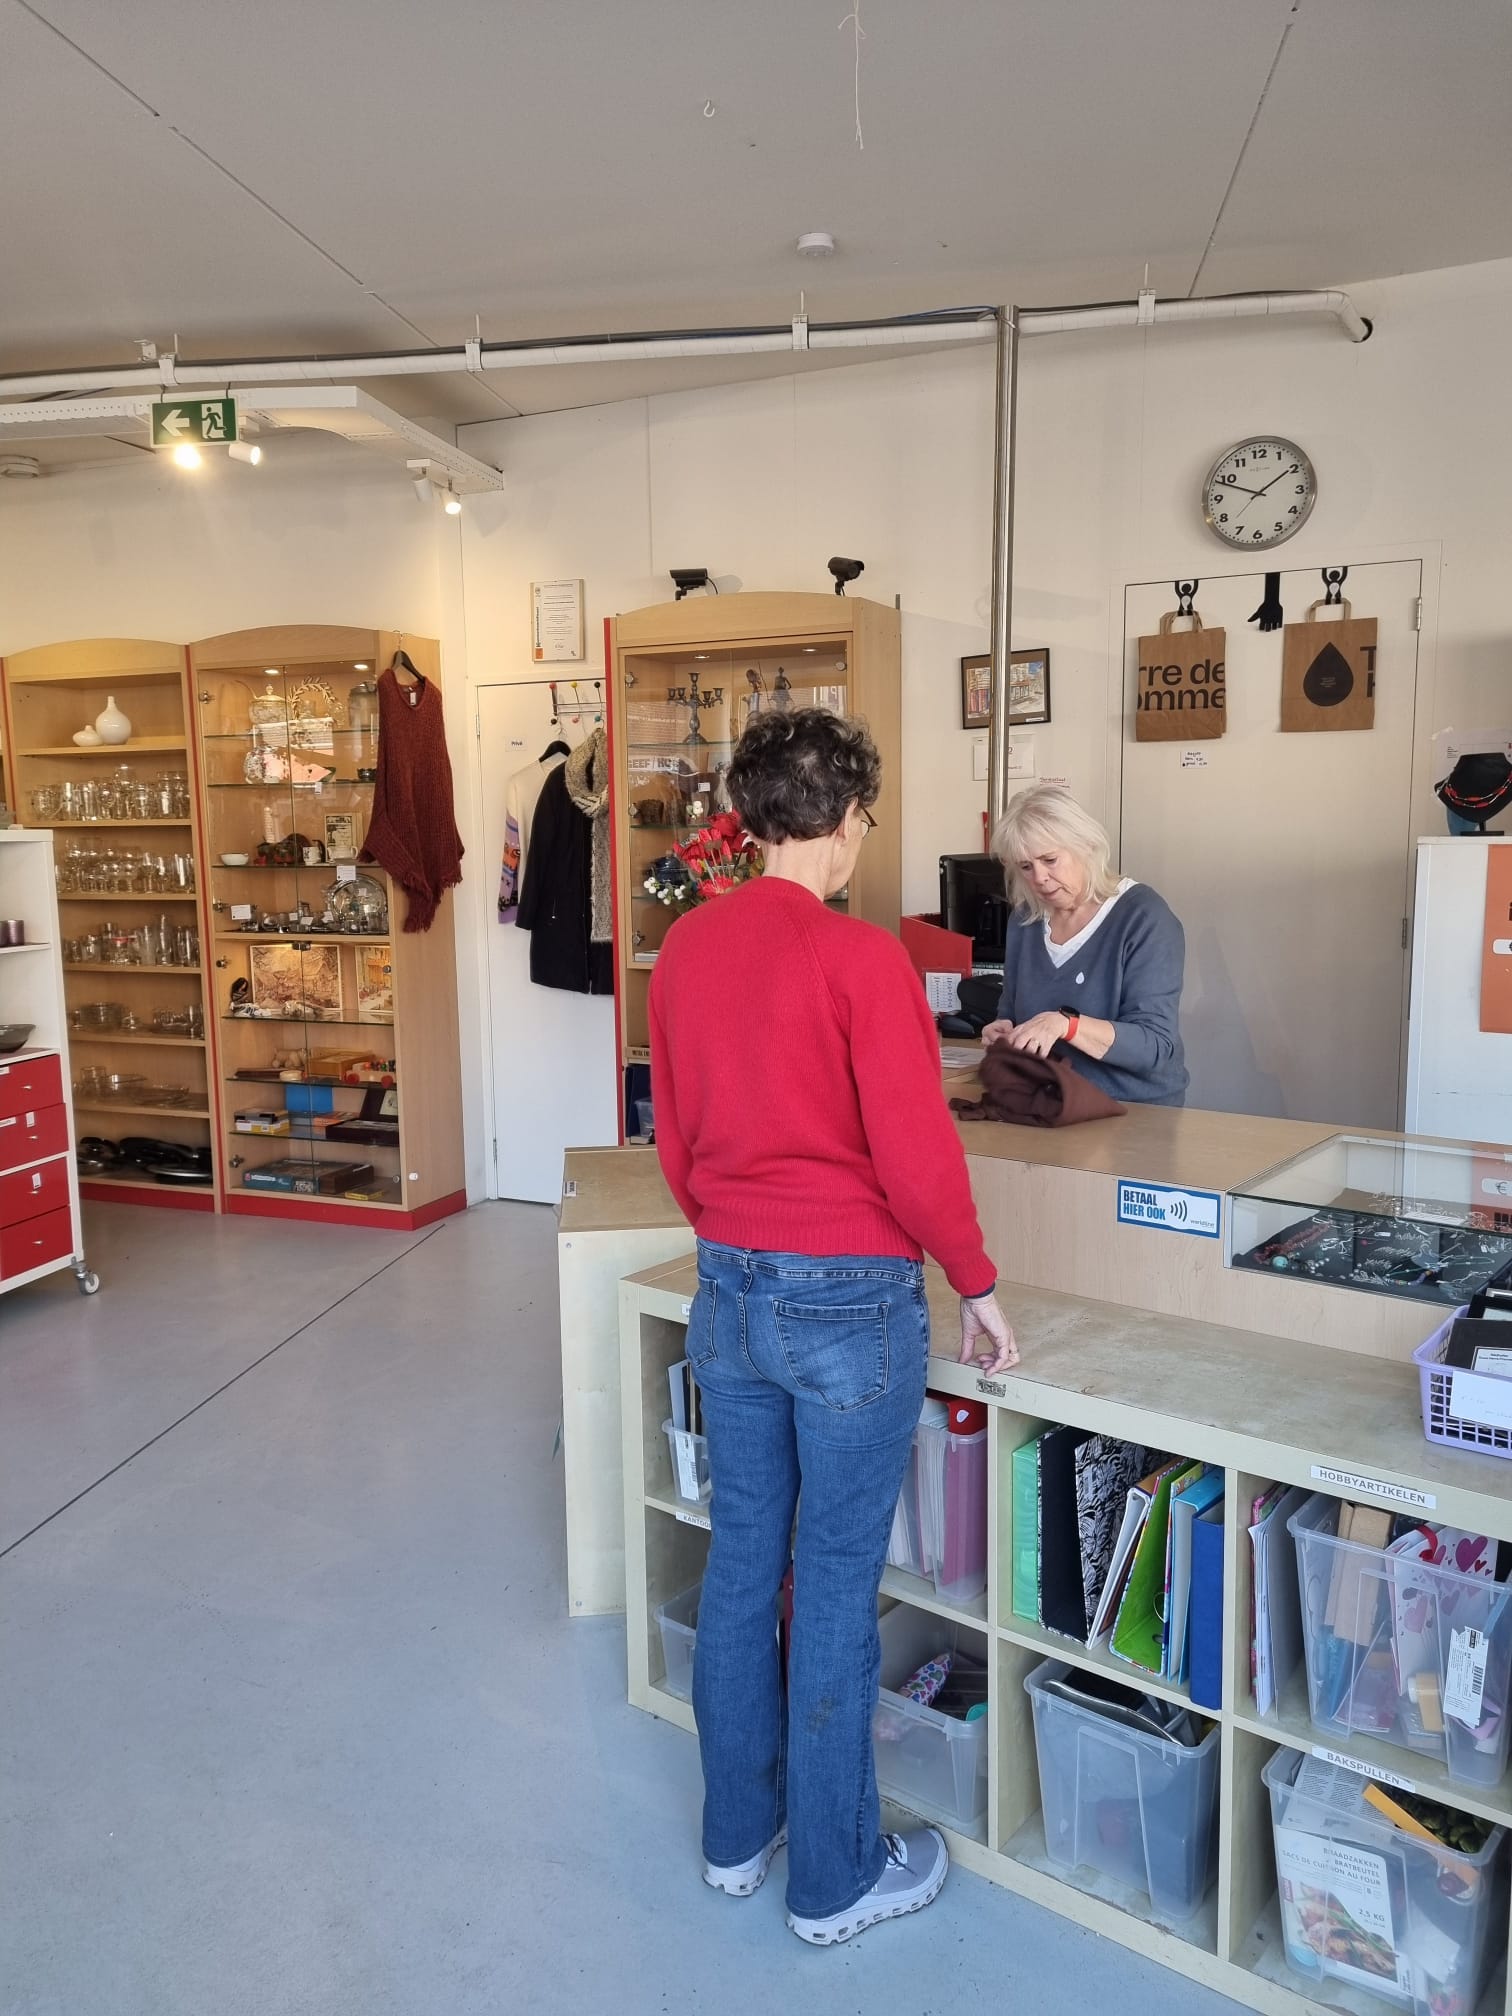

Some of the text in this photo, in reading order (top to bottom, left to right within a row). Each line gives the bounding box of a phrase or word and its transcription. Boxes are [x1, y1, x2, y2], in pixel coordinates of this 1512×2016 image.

[1251, 449, 1267, 459] 12
[1276, 451, 1282, 460] 1
[1234, 458, 1246, 468] 11
[1289, 464, 1299, 473] 2
[1220, 474, 1236, 484] 10
[1295, 485, 1304, 494] 3
[1214, 494, 1223, 504] 9
[1288, 505, 1298, 514] 4
[1219, 513, 1228, 522] 8
[1235, 526, 1244, 535] 7
[1274, 522, 1283, 531] 5
[1252, 530, 1262, 539] 6
[1138, 688, 1225, 711] mme
[1123, 1190, 1158, 1206] BETAAL
[1123, 1203, 1167, 1221] HIER OOK
[1319, 1469, 1426, 1504] HOBBYARTIKELEN
[1327, 1752, 1400, 1785] BAKSPULLEN
